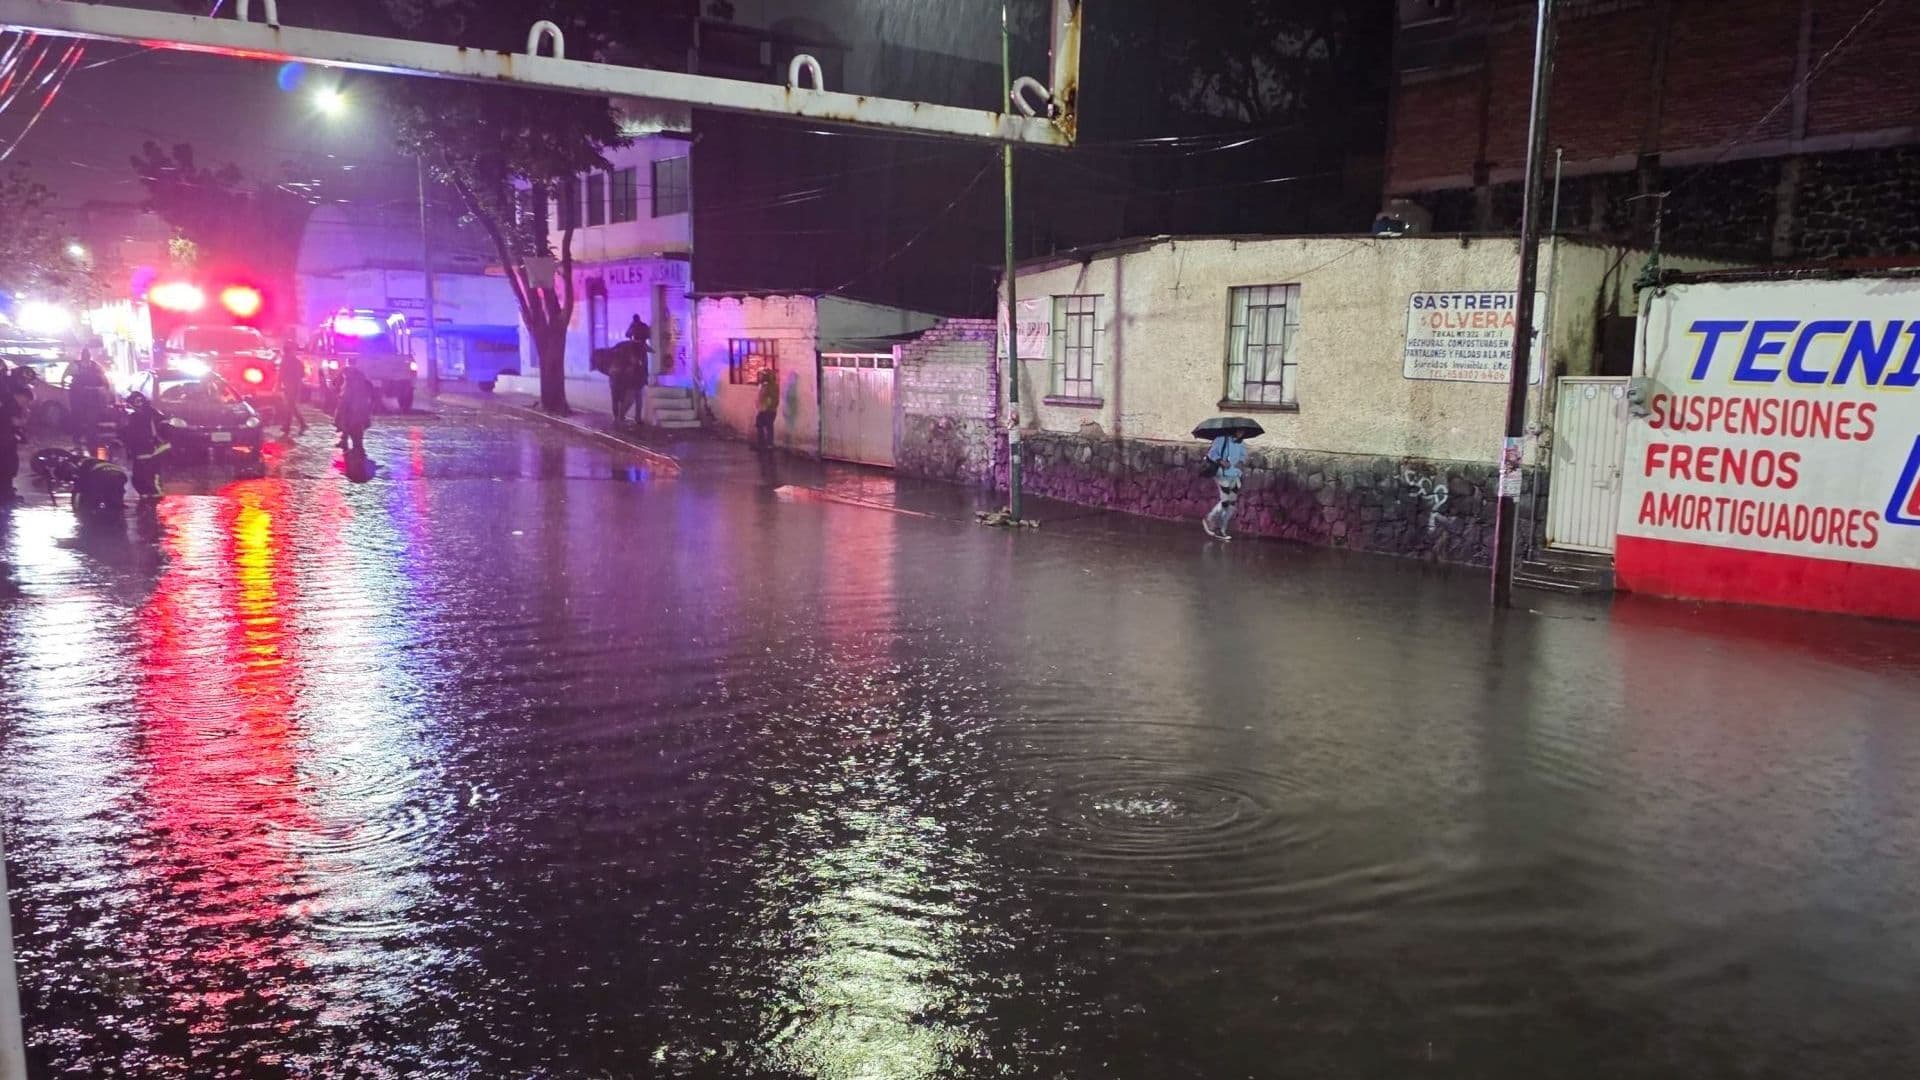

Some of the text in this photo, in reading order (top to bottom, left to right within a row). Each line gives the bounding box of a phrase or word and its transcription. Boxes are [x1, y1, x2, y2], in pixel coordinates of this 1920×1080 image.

[1413, 294, 1514, 309] SASTRERI
[1430, 311, 1515, 329] OLVERA
[1648, 393, 1877, 442] SUSPENSIONES
[1645, 443, 1802, 489] FRENOS
[1638, 491, 1880, 549] AMORTIGUADORES
